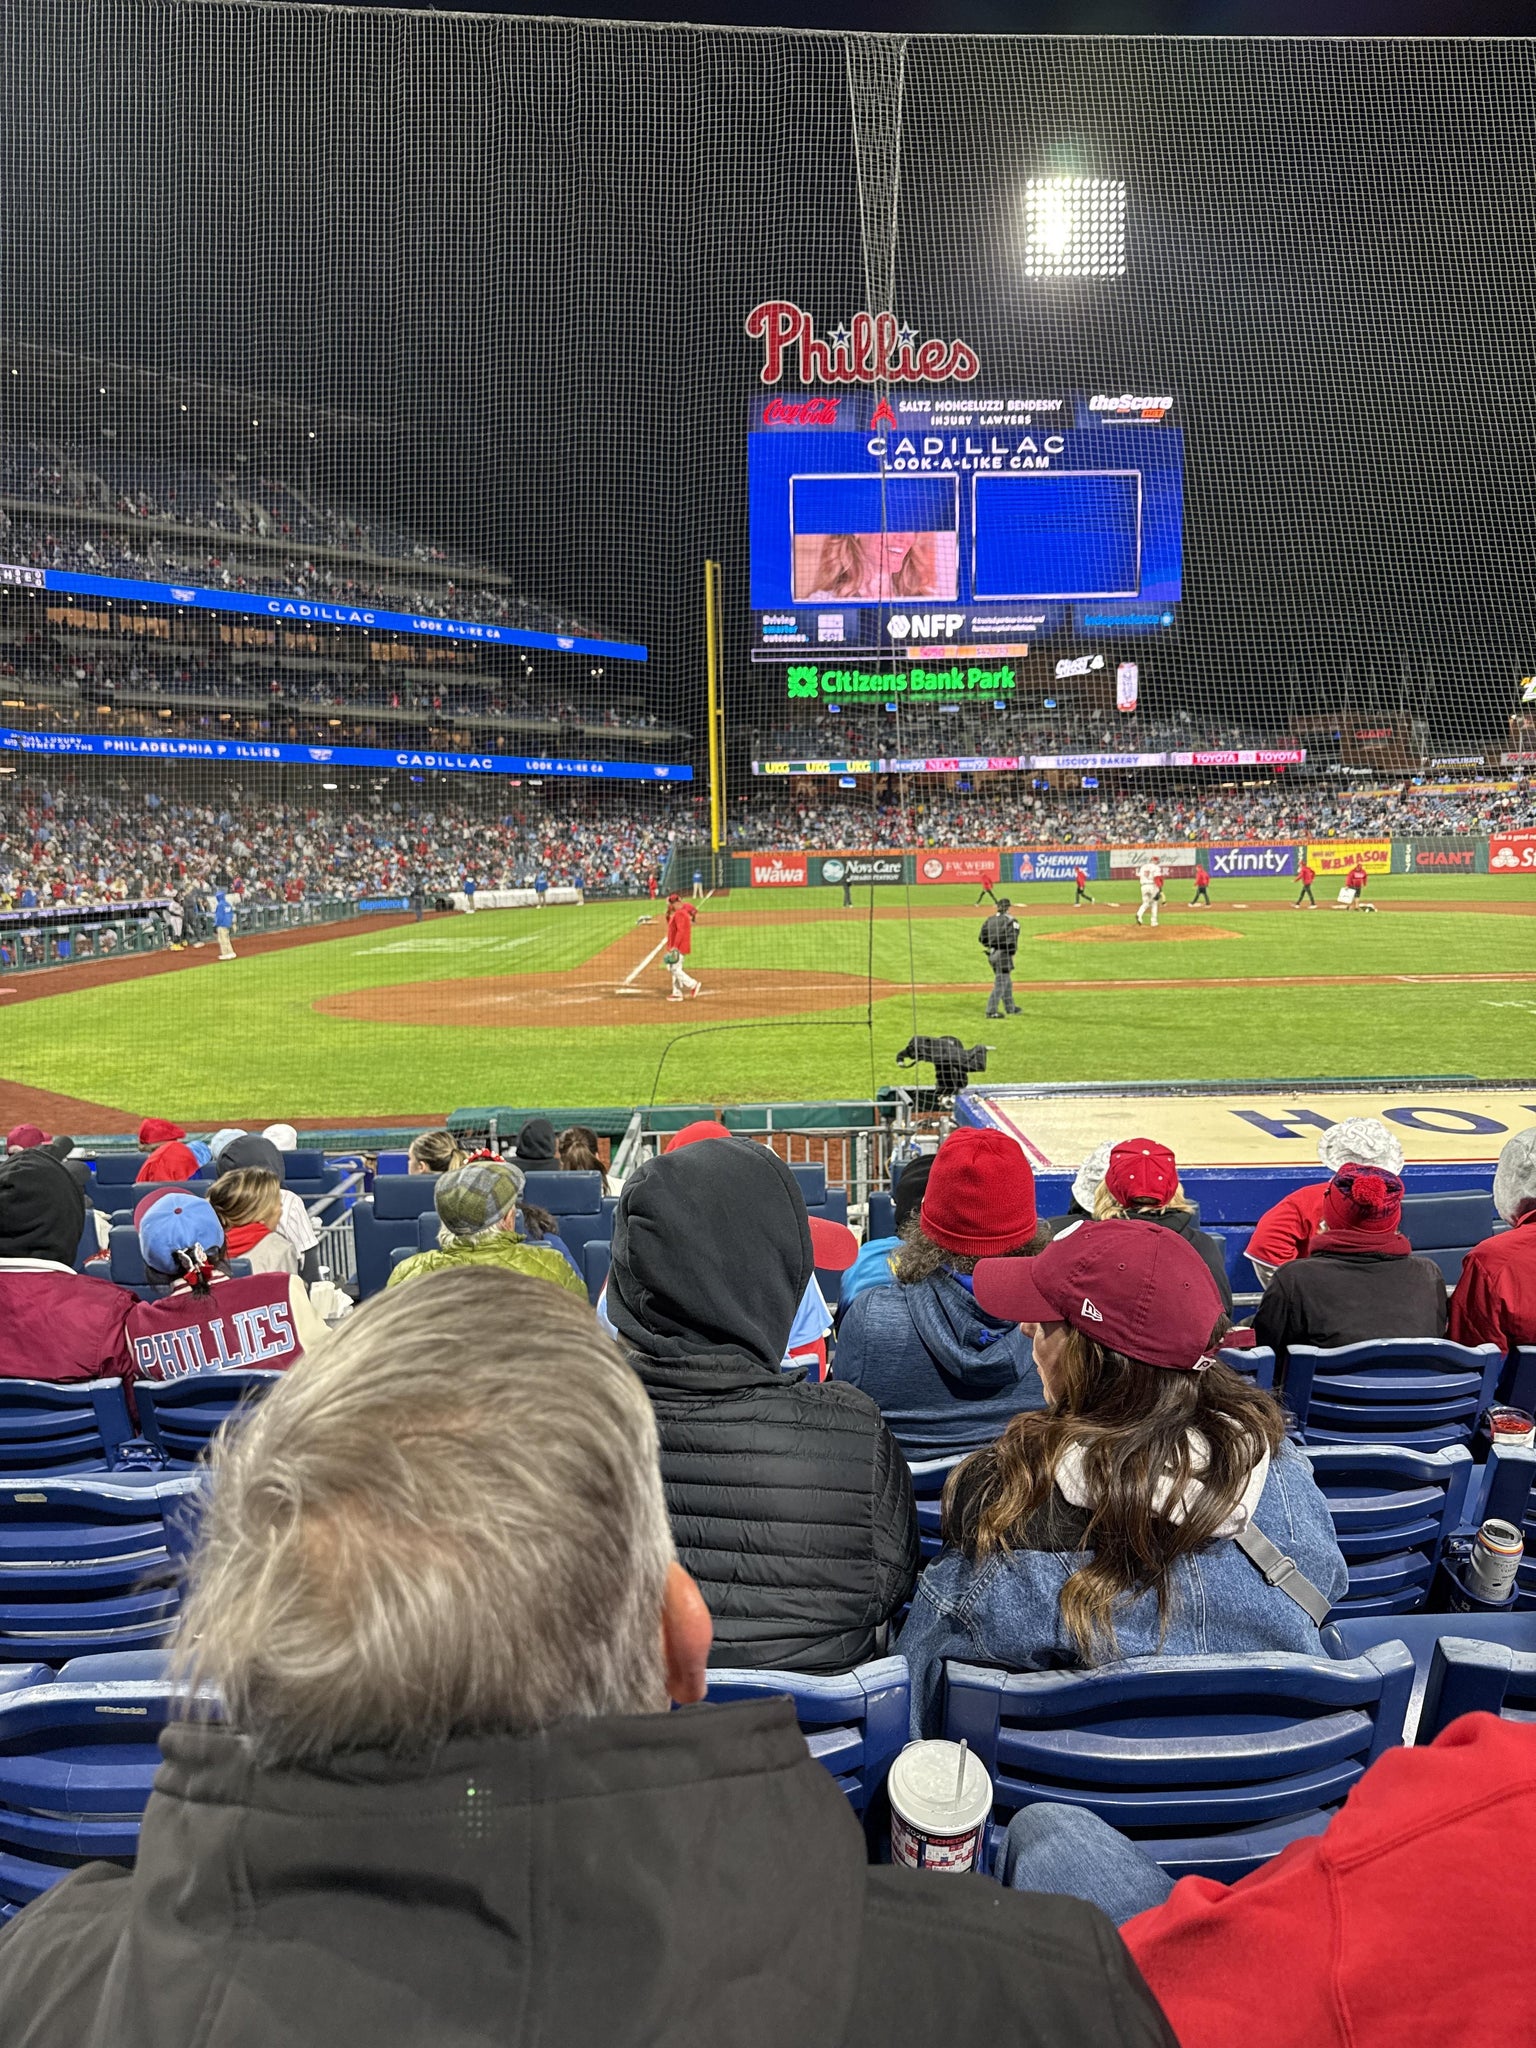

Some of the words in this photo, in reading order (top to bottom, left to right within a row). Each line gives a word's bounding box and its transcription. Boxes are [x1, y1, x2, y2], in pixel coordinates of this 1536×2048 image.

[745, 300, 981, 385] Phillies
[899, 401, 931, 412] SALTZ
[935, 400, 1004, 411] MONGELUZZI
[1007, 399, 1063, 411] BENDESKY
[1089, 394, 1174, 411] theScore
[930, 415, 973, 426] INJURY
[980, 414, 1032, 425] LAWYERS
[867, 435, 1065, 456] CADILLAC
[884, 457, 1002, 471] LOOK-A-LIKE
[1010, 455, 1050, 469] CAM
[267, 601, 375, 624] CADILLAC
[413, 619, 442, 631] LOOK
[911, 614, 963, 638] NFP
[821, 671, 907, 693] Citizens
[910, 667, 965, 690] Bank
[967, 665, 1016, 690] Park
[103, 740, 213, 755] PHILADELPHIA
[396, 753, 493, 769] CADILLAC
[1100, 757, 1140, 765] BAKERY
[1195, 753, 1236, 763] TOYOTA
[1259, 752, 1299, 761] TOYOTA
[526, 761, 552, 771] LOOK
[965, 860, 995, 870] WEBB
[1036, 854, 1088, 867] SHERWIN
[1214, 848, 1290, 874] xfinity
[1416, 851, 1475, 865] GIANT
[754, 867, 803, 883] Wawa
[135, 1302, 299, 1380] PHILLIES
[905, 1826, 928, 1842] 2026
